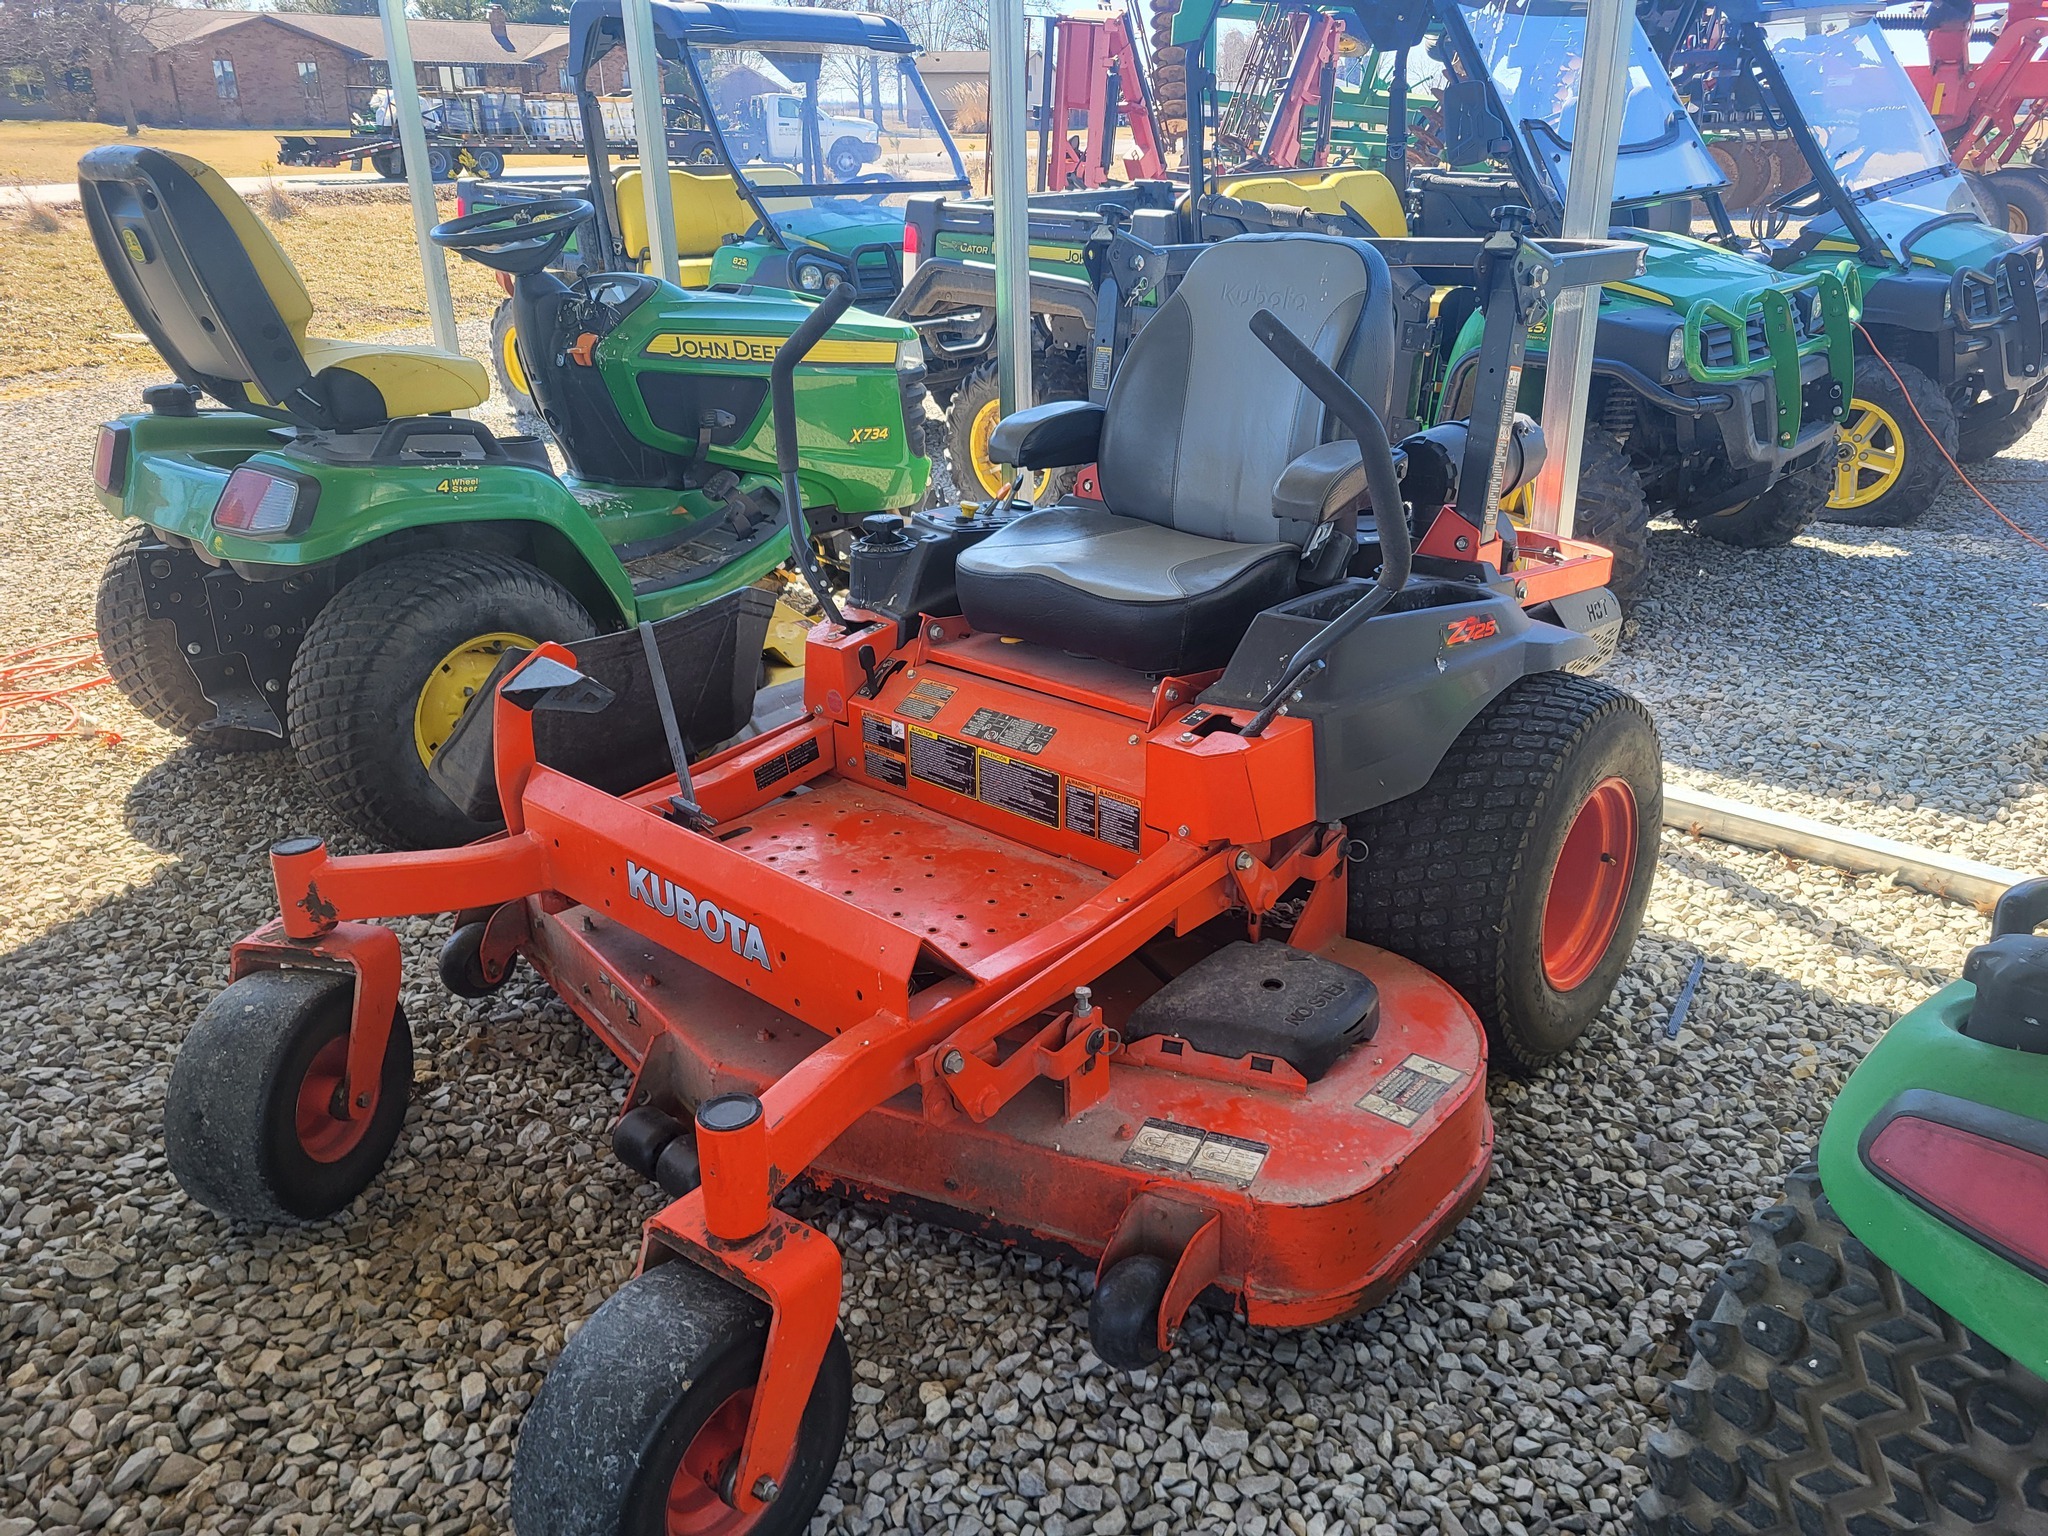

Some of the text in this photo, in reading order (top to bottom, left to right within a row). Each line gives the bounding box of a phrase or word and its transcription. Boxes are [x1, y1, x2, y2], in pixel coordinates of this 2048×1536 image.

[960, 243, 988, 254] GATOR
[1220, 281, 1308, 311] Kubota
[670, 336, 782, 360] JOHN DEE
[849, 427, 888, 444] X734
[437, 477, 479, 493] 4 Wheel
[451, 485, 478, 493] Steer
[1586, 598, 1608, 623] HOT
[1446, 619, 1496, 646] Z725
[626, 858, 773, 973] KUBOTA
[1284, 982, 1347, 1027] NO STEP
